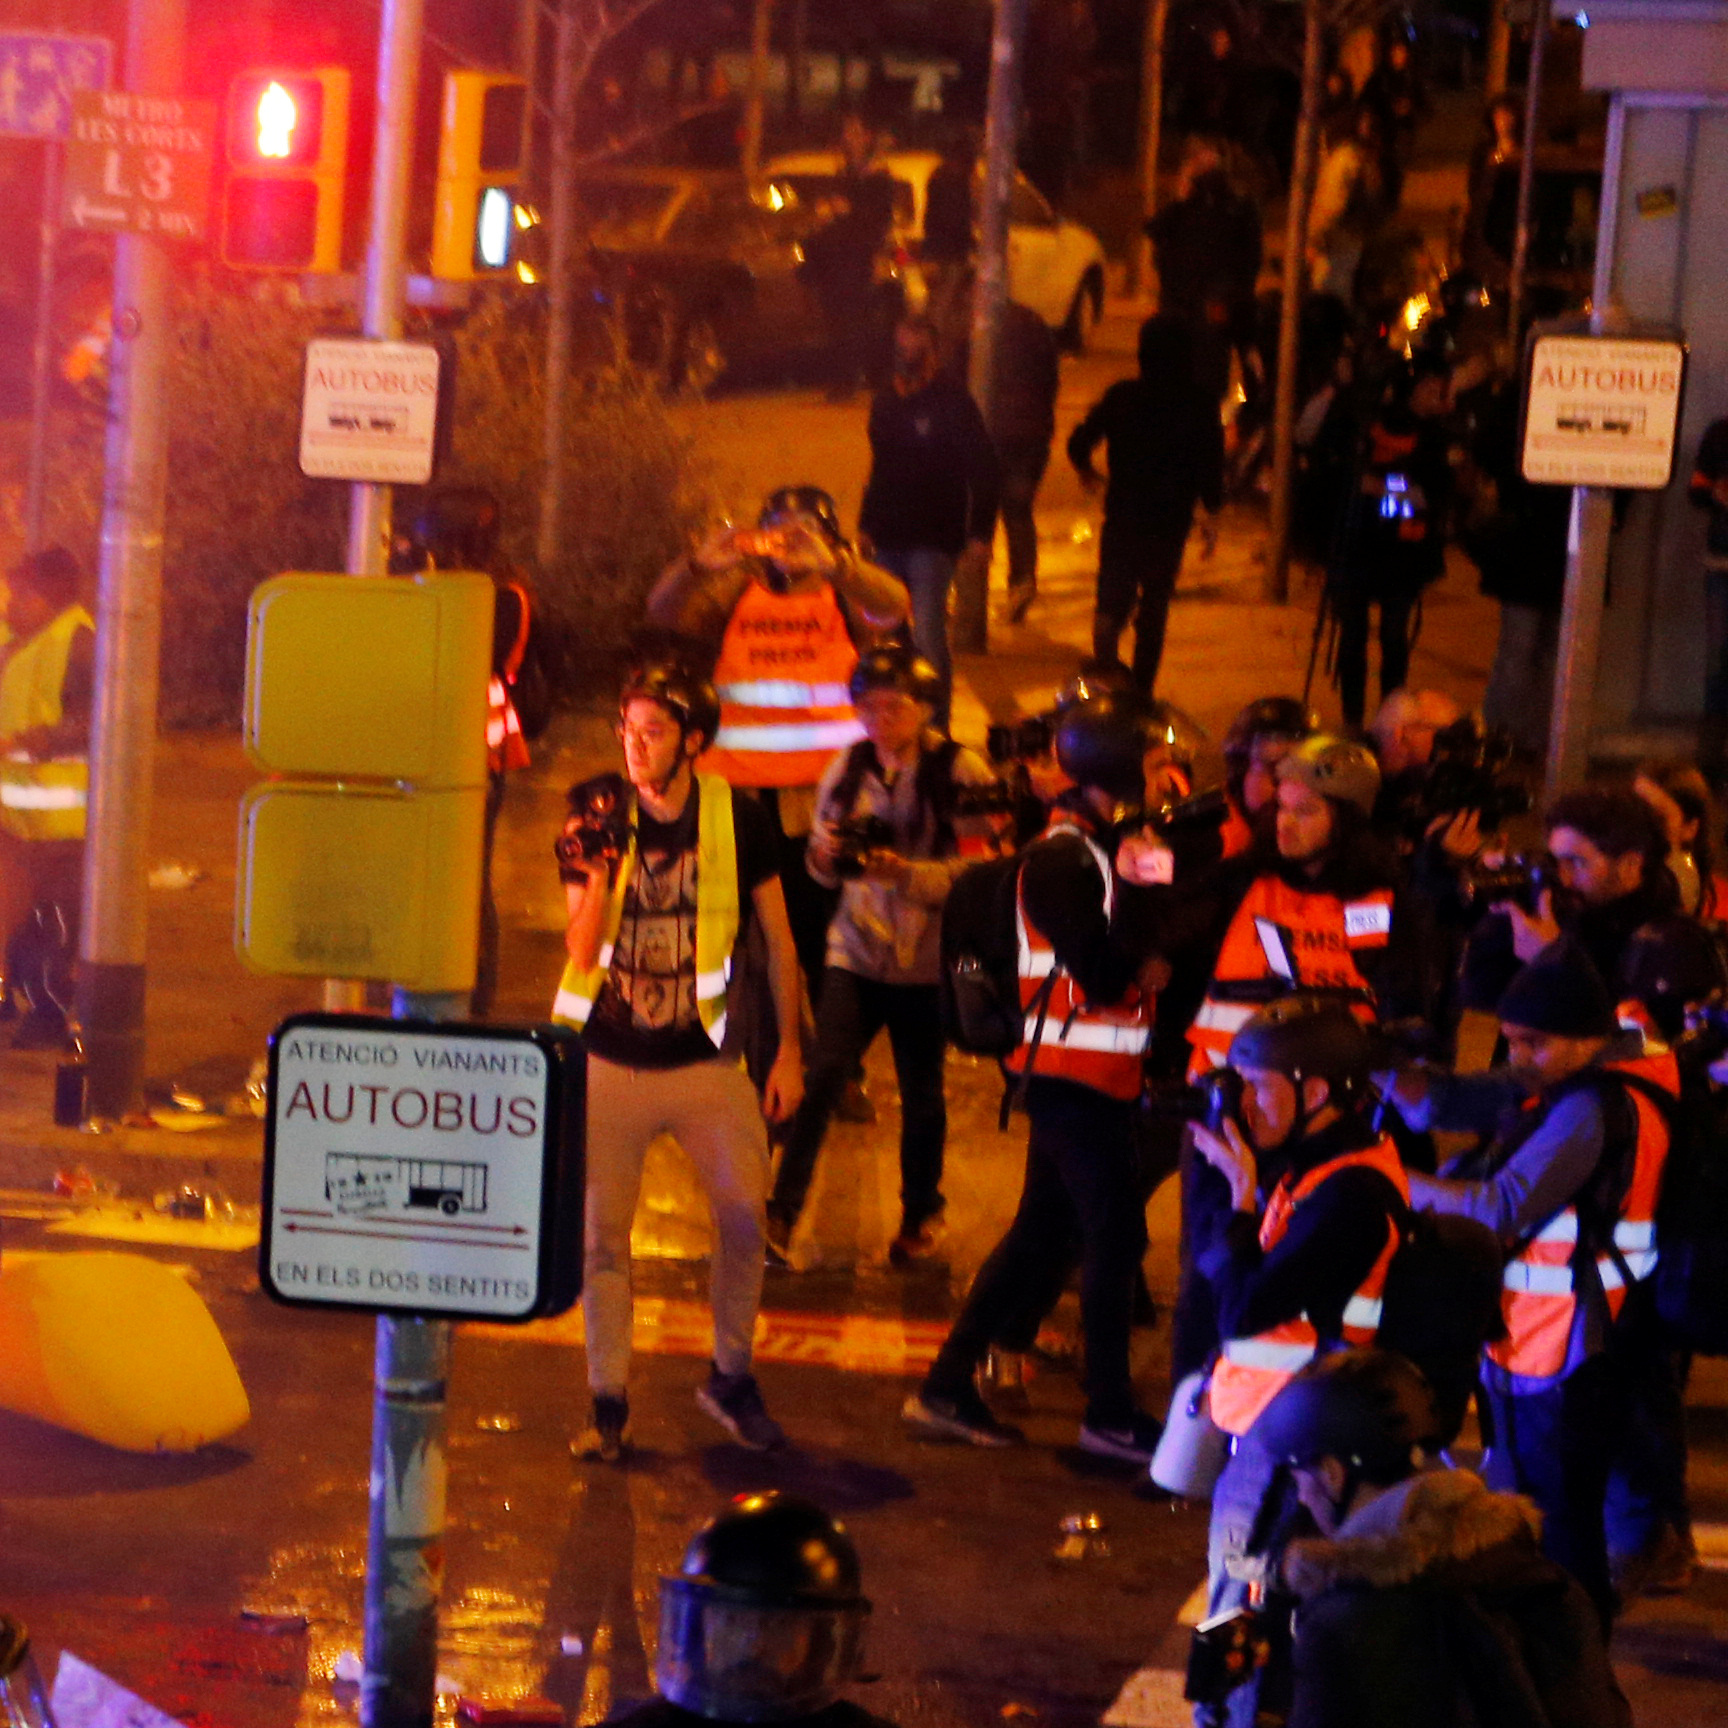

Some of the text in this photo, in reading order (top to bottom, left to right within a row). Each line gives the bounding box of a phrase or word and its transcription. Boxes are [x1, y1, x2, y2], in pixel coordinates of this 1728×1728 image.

[311, 367, 436, 396] AUTOBUS
[1538, 364, 1676, 395] AUTOBUS
[414, 1048, 539, 1078] VIANANTS
[285, 1080, 537, 1137] AUTOBUS
[277, 1261, 530, 1299] EN ELS DOS SENTITS
